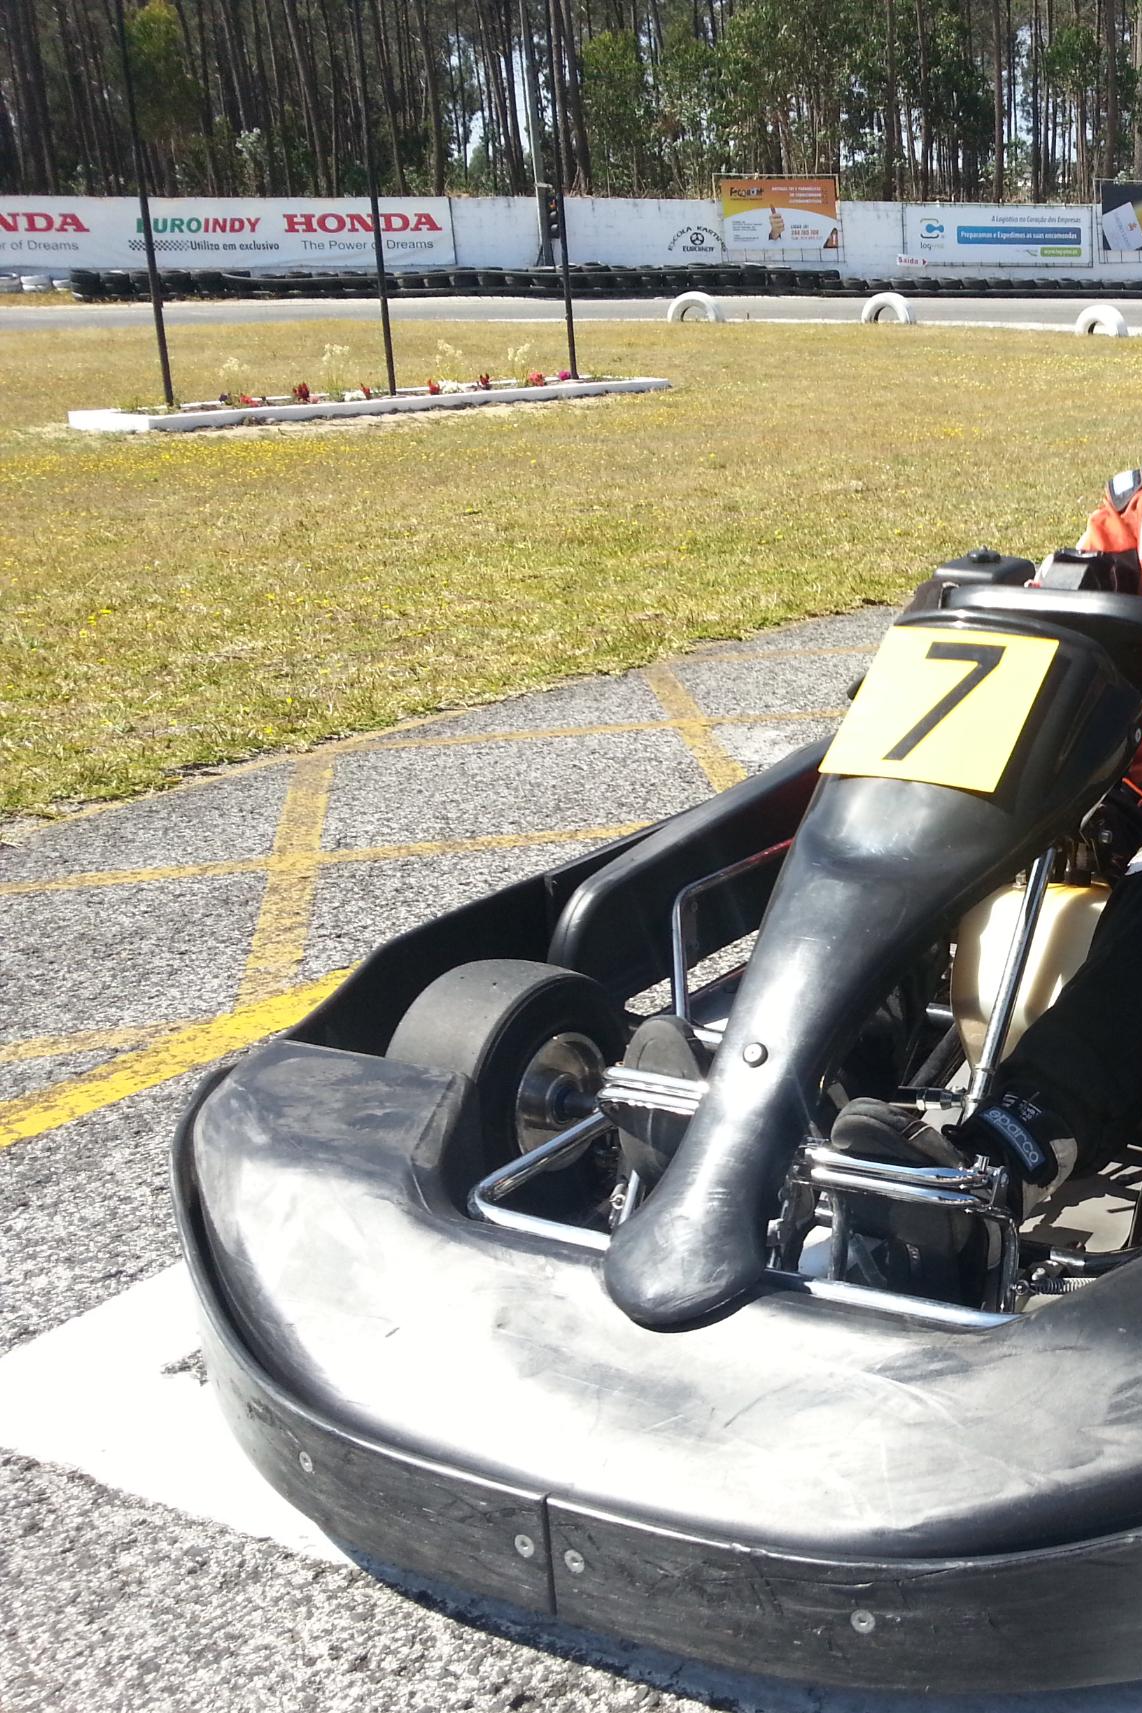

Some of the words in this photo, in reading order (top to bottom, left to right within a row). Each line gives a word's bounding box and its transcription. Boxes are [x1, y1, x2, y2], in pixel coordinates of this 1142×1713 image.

[283, 213, 442, 233] HONDA
[27, 240, 79, 251] Dreams
[223, 242, 236, 250] em
[239, 240, 280, 251] exclusivo
[301, 240, 325, 250] The
[329, 240, 366, 251] Power
[386, 239, 434, 249] Dreams
[882, 641, 1007, 761] 7
[988, 1108, 1039, 1163] sparco
